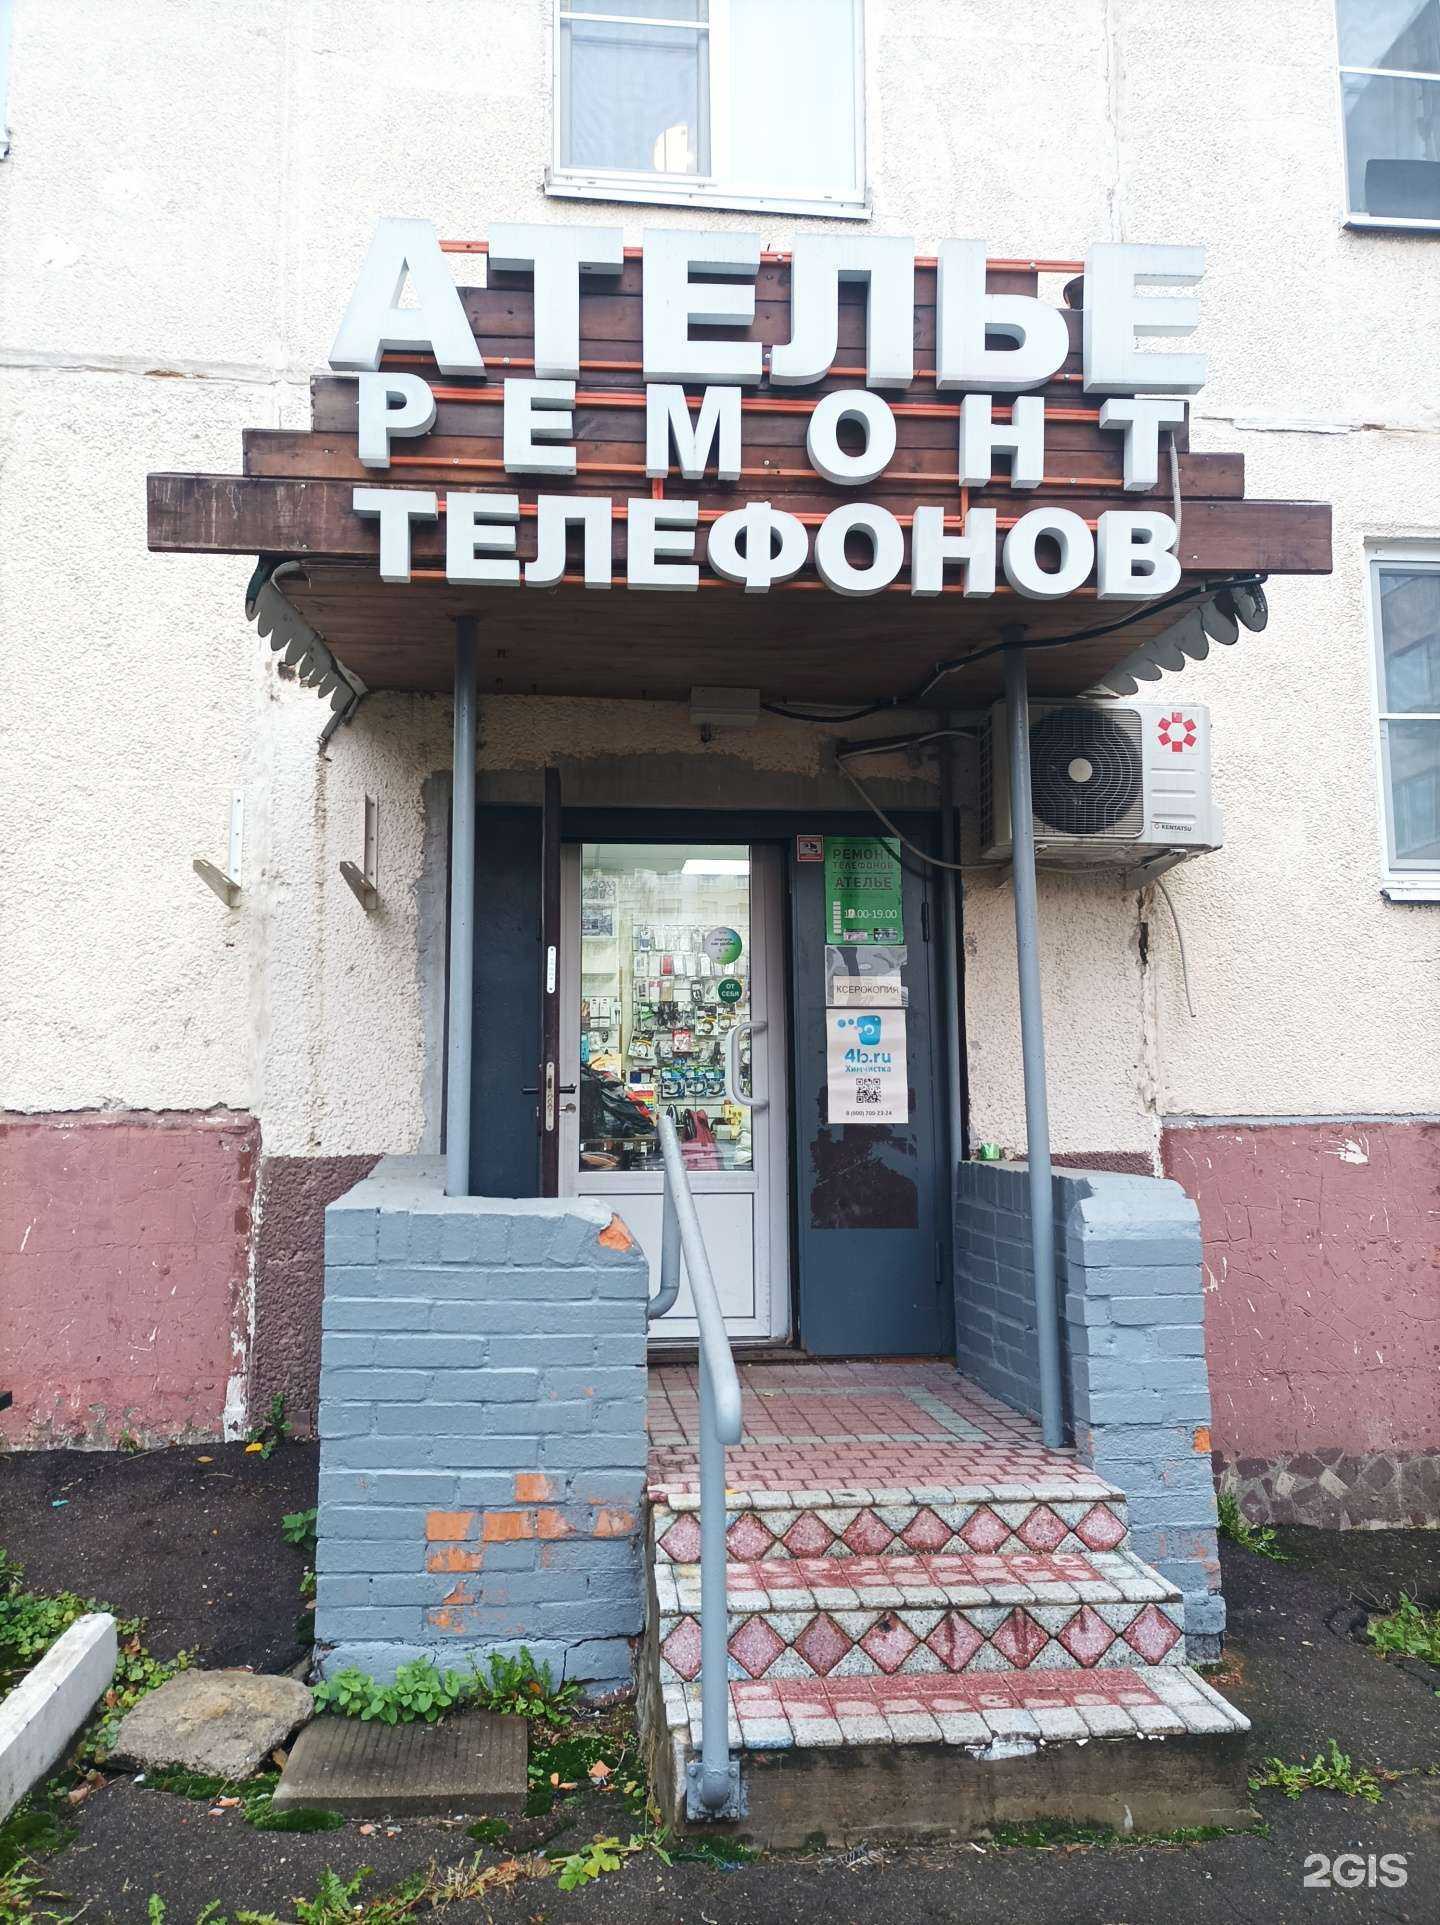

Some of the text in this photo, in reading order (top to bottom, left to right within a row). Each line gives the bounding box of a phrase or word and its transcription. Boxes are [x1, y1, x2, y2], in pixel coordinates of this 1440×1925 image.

[328, 218, 1206, 395] АТЕЛЬЕ
[358, 372, 1185, 492] РЕМОНТ
[352, 488, 1182, 598] ТЕЛЕФОНОВ
[1161, 824, 1192, 832] KENTATSU
[836, 877, 892, 888] АТЕЛЬЕ
[836, 985, 899, 994] КСЕРОКОПИЯ
